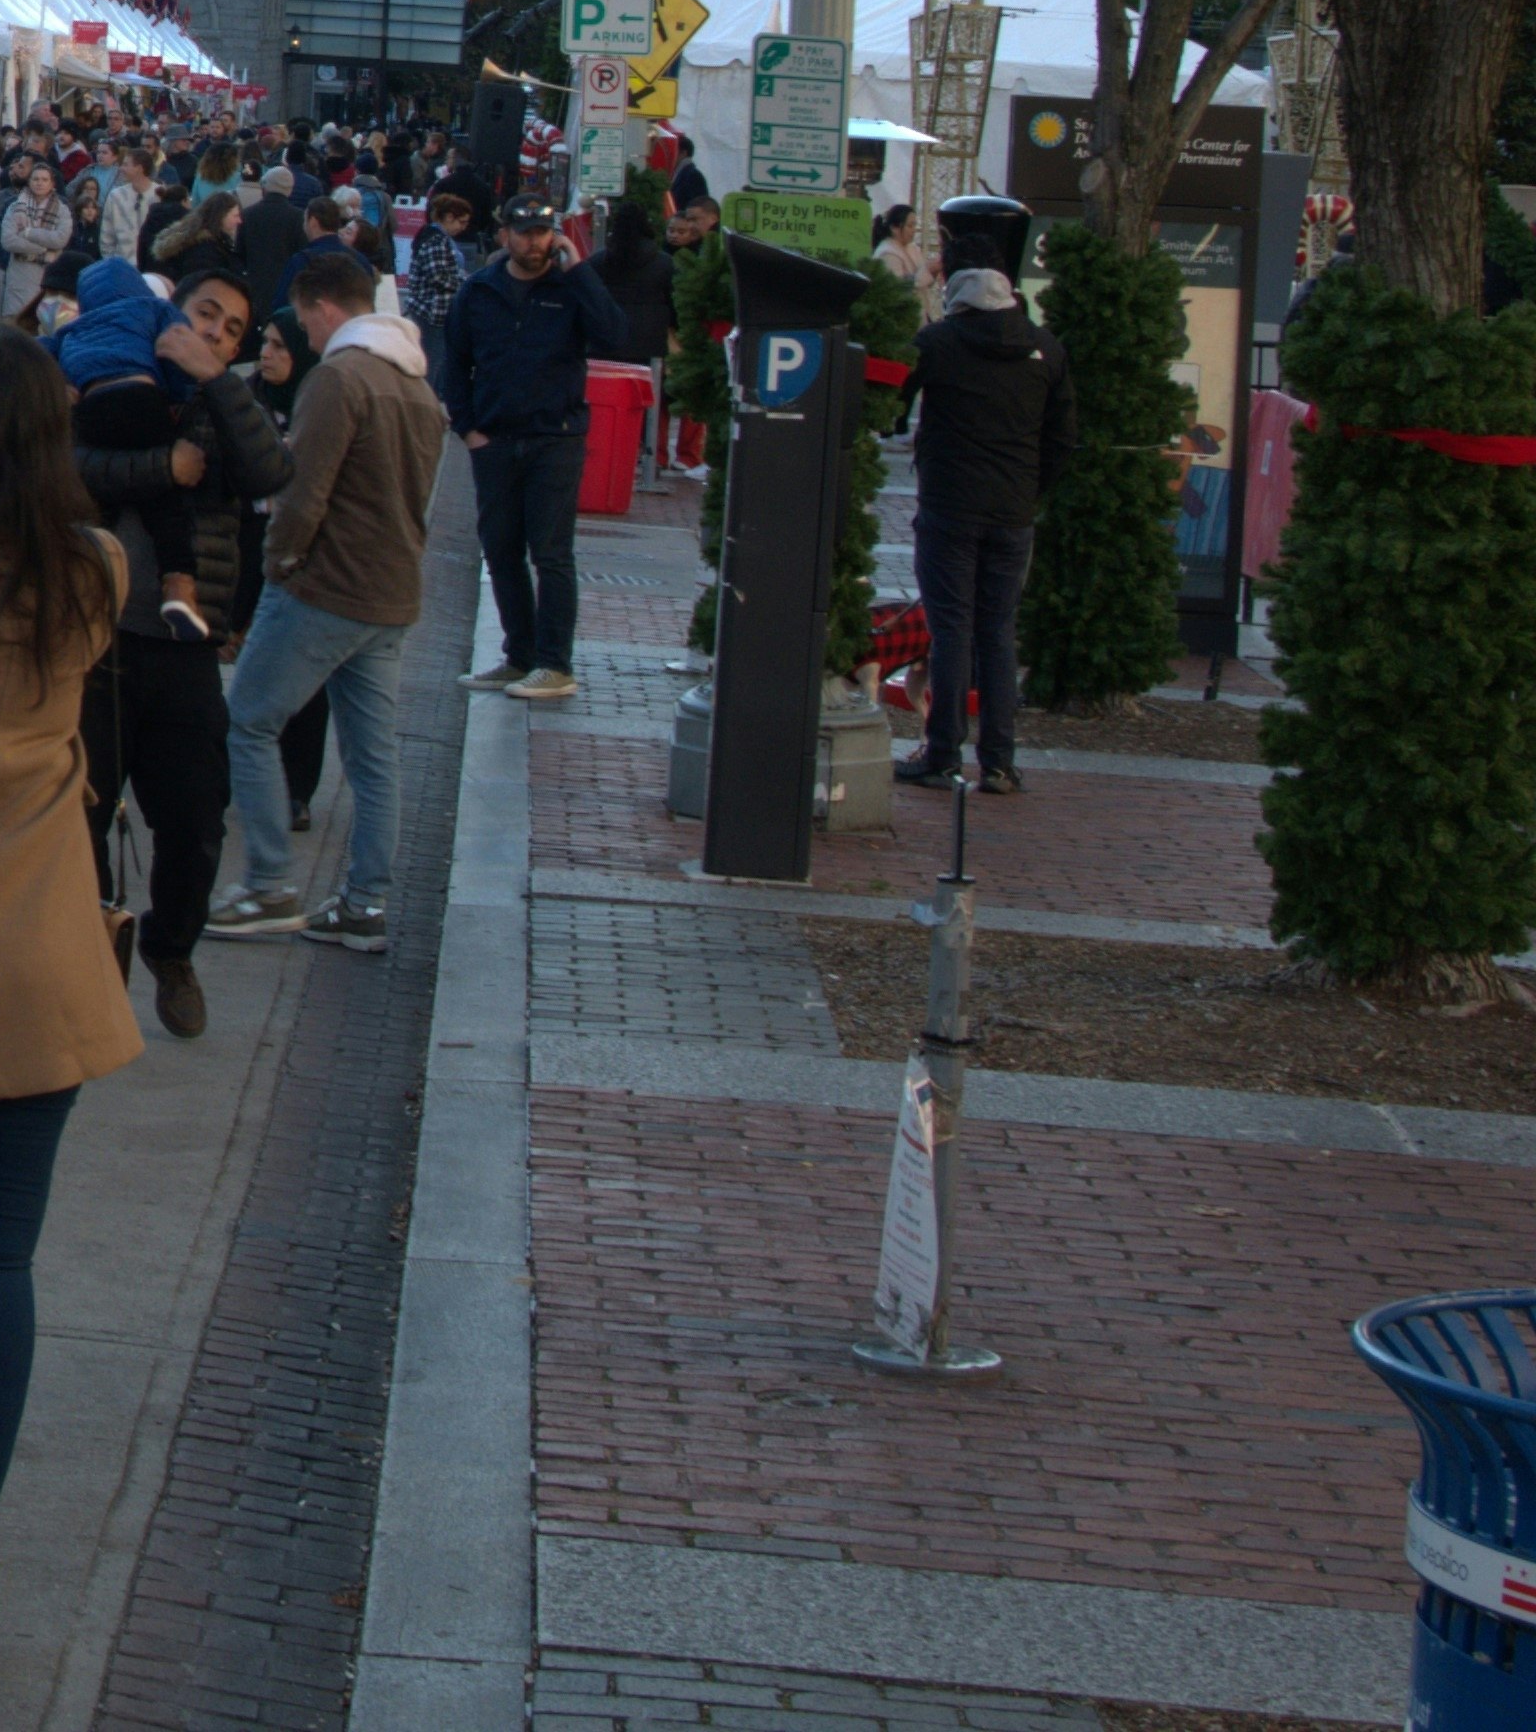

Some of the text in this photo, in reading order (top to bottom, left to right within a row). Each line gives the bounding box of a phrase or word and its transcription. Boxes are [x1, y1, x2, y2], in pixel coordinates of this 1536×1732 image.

[805, 45, 824, 56] PAY
[792, 56, 834, 67] TO PARK
[760, 79, 770, 92] 2
[1192, 137, 1232, 153] Center
[1232, 139, 1252, 154] for
[1178, 151, 1243, 167] Portraiture
[761, 201, 860, 220] Pay by Phone
[761, 218, 817, 236] Parking
[1216, 254, 1235, 266] Art
[766, 336, 805, 392] P
